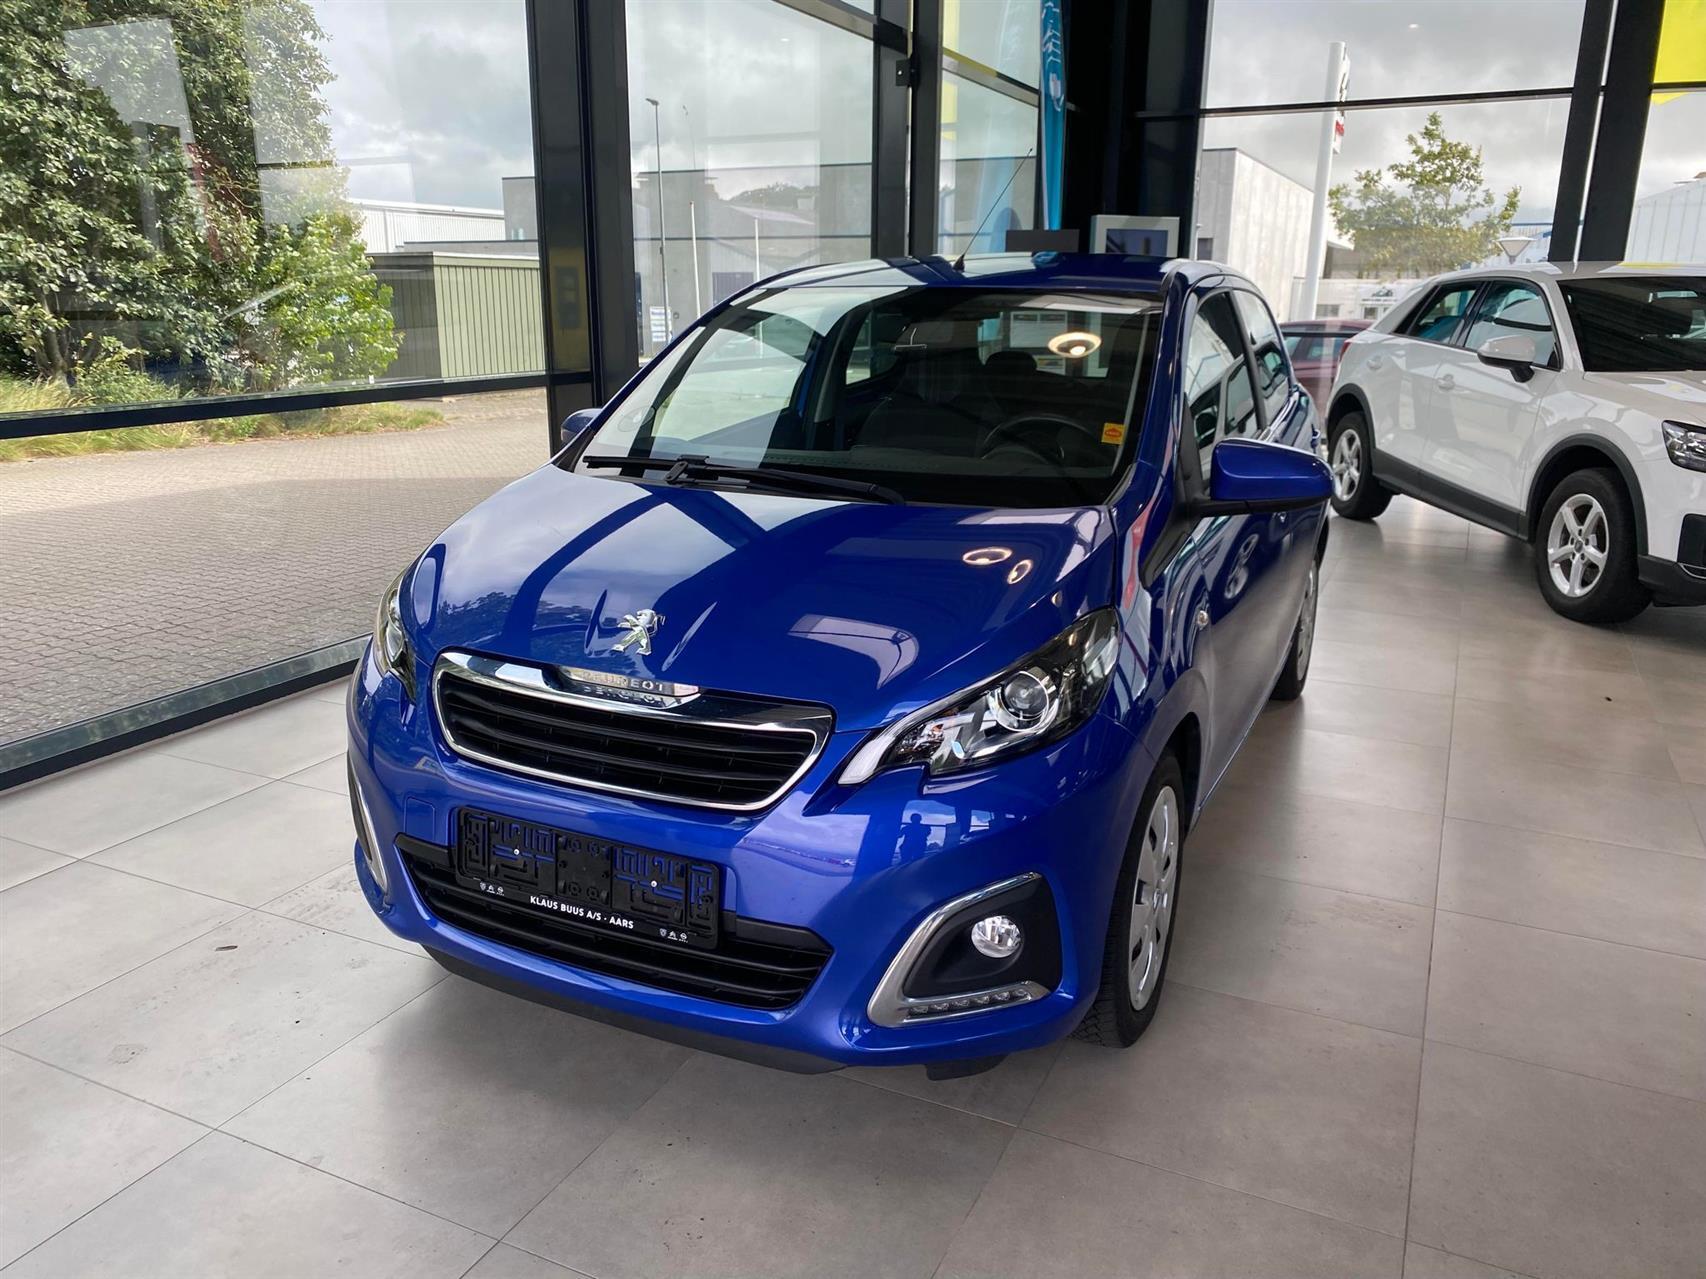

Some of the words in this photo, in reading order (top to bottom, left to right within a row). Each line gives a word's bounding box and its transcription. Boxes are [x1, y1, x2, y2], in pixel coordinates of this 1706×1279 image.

[530, 896, 558, 909] KLAUS
[560, 903, 585, 917] BUUS
[586, 910, 602, 921] A/S
[609, 916, 634, 929] AARS
